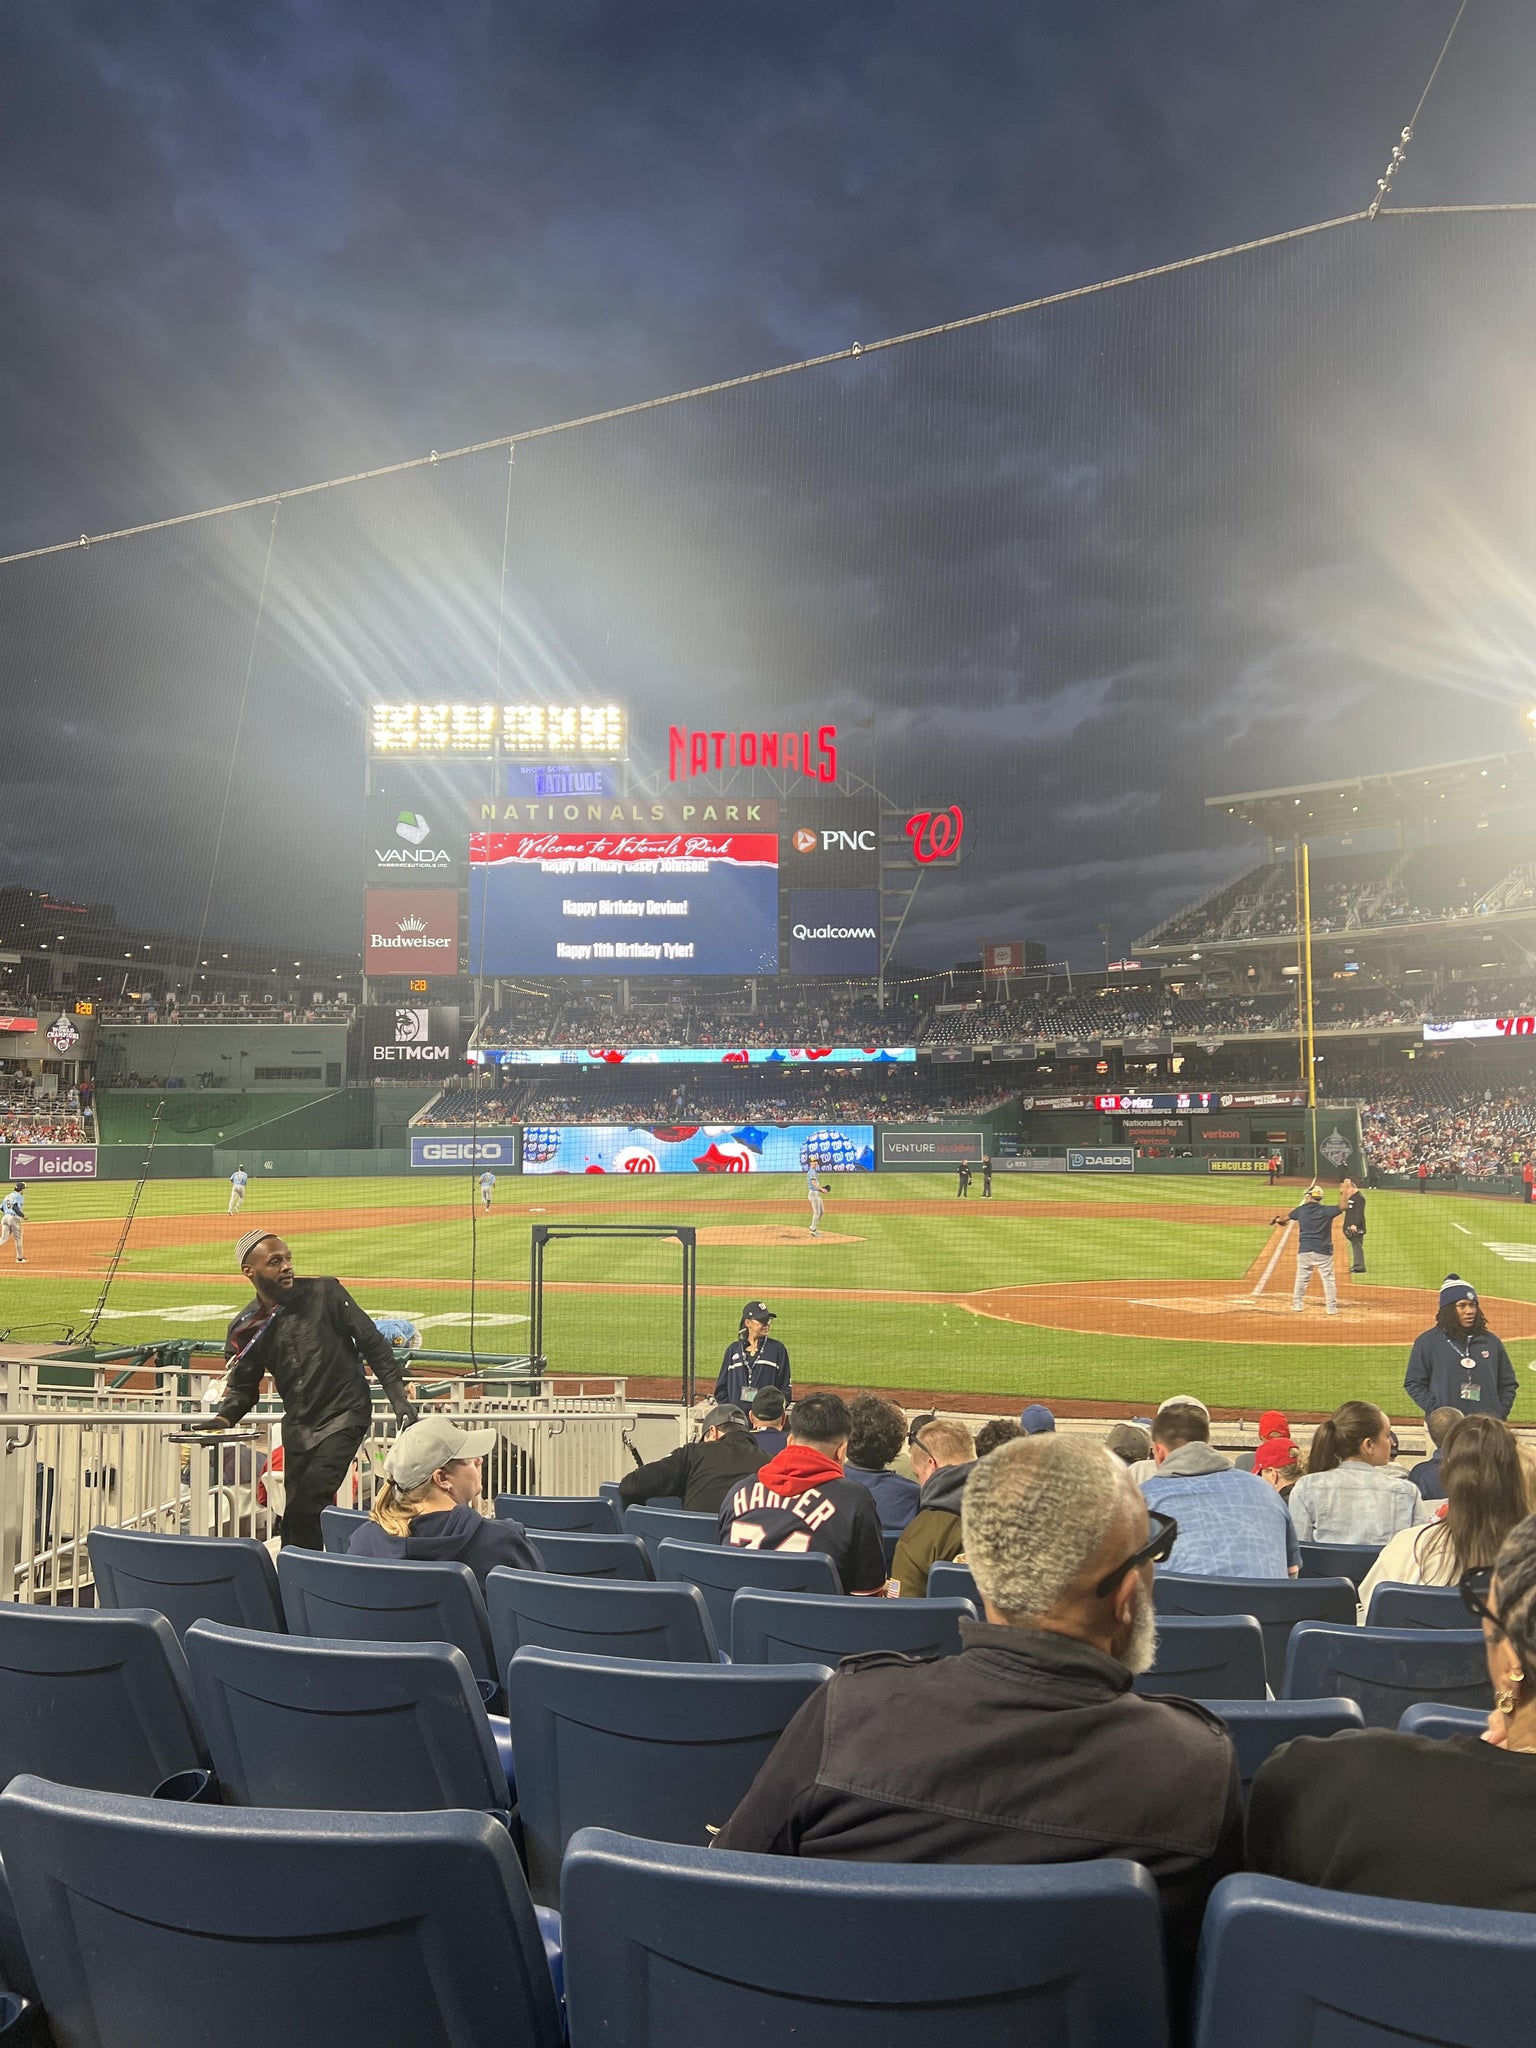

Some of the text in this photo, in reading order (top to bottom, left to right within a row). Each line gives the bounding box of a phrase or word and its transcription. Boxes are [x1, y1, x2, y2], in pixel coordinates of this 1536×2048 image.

[669, 725, 837, 783] NATIONALS
[546, 765, 570, 773] SOME
[481, 804, 762, 821] NATIONALS PARK
[517, 834, 733, 858] Welcome to Nationals Park
[821, 830, 876, 851] PNC
[374, 849, 451, 862] VANDA
[541, 860, 576, 873] Happy
[577, 860, 622, 874] Birthday
[659, 860, 709, 872] Johnson!
[562, 900, 597, 916] Happy
[598, 900, 645, 916] Birthday
[792, 924, 876, 941] Qualcomm
[370, 934, 452, 948] Budweiser
[556, 943, 694, 959] Happy 11th Birthday Tyler!
[410, 980, 426, 991] 1:28
[373, 1046, 449, 1060] BETMGM
[1234, 1094, 1277, 1103] WASHINGTON
[1254, 1097, 1290, 1106] NATIONALS
[1129, 1128, 1178, 1136] powered by
[1202, 1129, 1240, 1139] verizon
[423, 1143, 502, 1160] GEICO
[888, 1143, 936, 1152] VENTURE
[39, 1156, 94, 1173] leidos
[1085, 1156, 1131, 1165] DABOS
[1211, 1161, 1252, 1171] HERCULES
